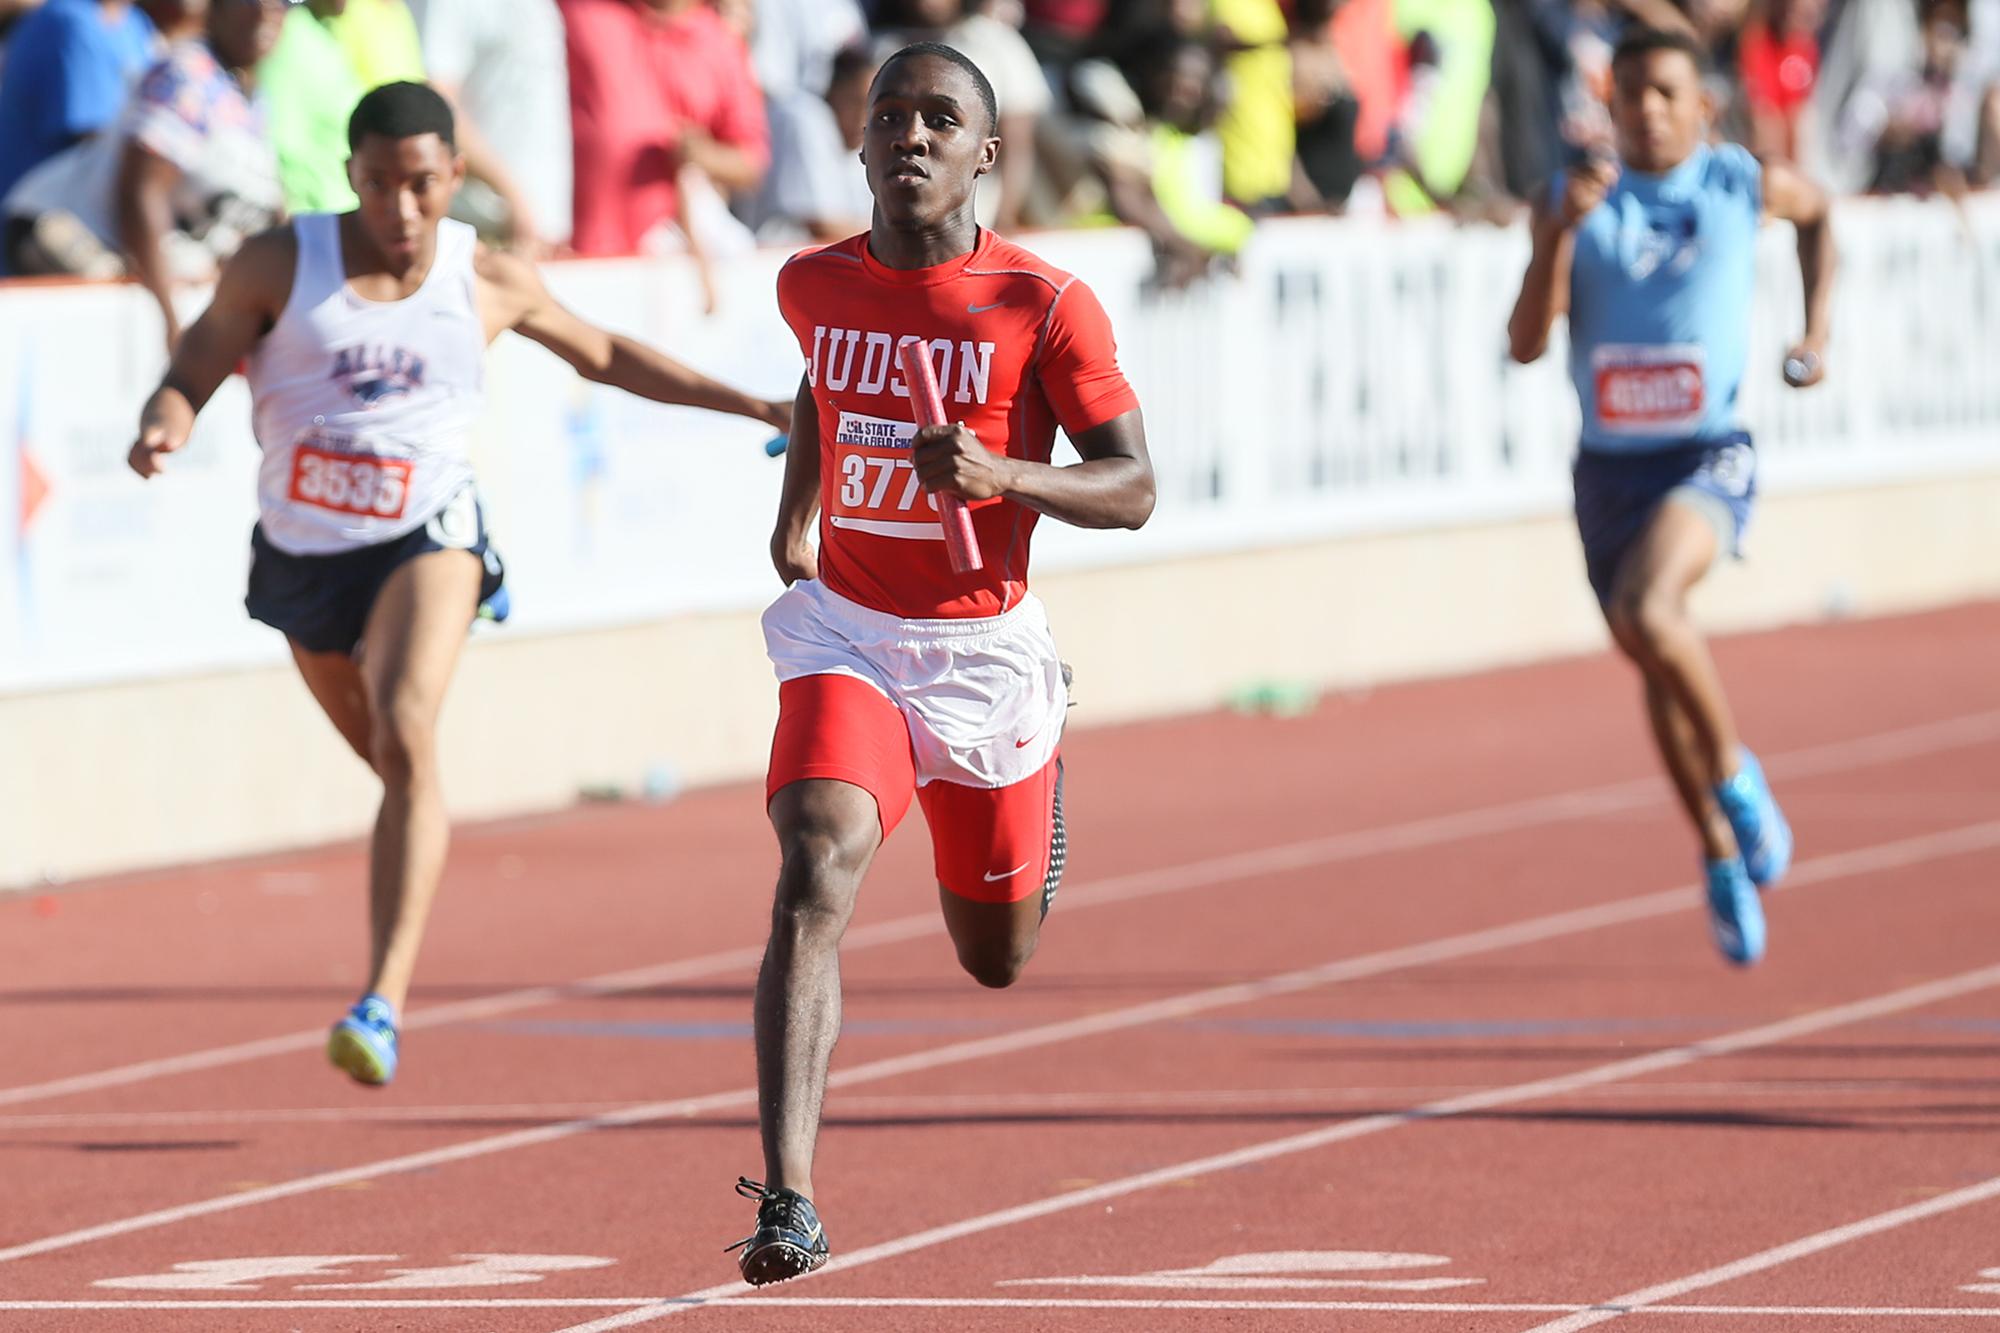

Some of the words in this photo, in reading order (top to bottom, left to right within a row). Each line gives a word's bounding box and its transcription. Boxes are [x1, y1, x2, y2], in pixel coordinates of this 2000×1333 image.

[806, 326, 996, 404] JUDSON
[839, 433, 863, 446] TRACK
[870, 437, 893, 448] FIELD
[865, 422, 896, 437] STATE
[299, 453, 406, 515] 3535
[841, 454, 940, 512] 377
